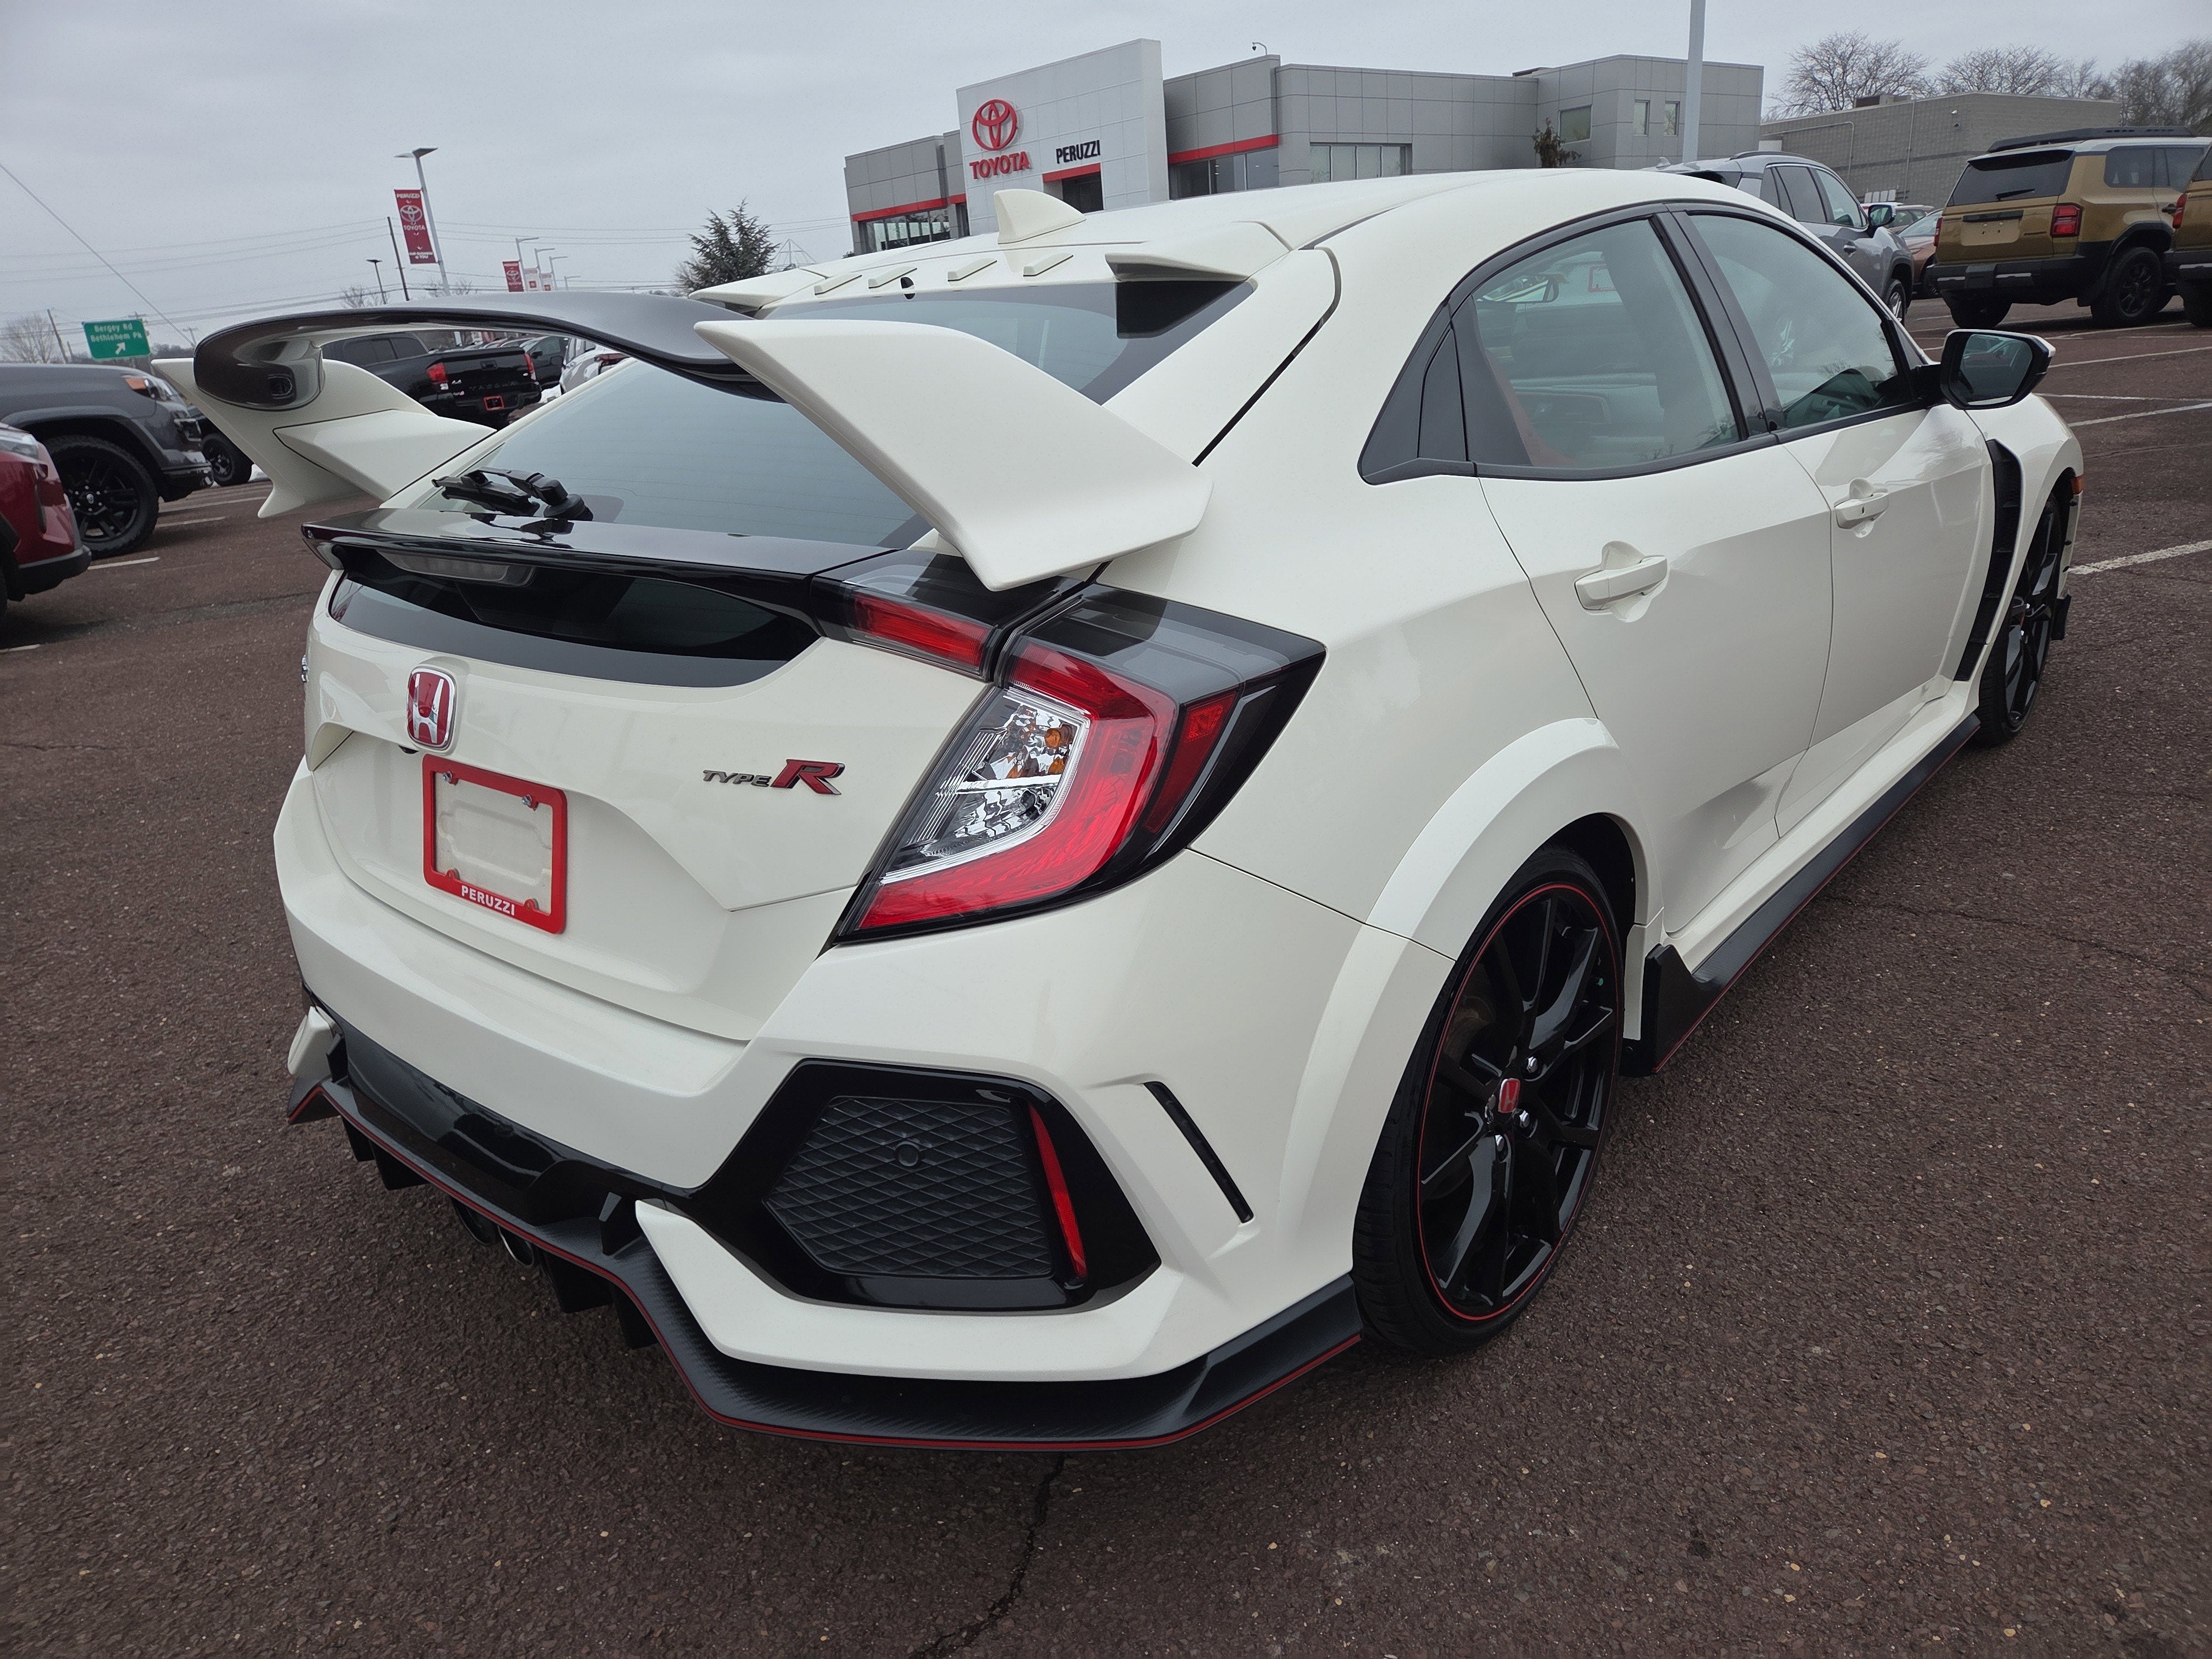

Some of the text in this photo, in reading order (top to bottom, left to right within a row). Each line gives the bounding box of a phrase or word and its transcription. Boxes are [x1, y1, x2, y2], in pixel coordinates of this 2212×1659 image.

[969, 151, 1031, 179] TOYOTA
[1056, 140, 1101, 164] PERUZZI
[703, 759, 845, 795] TYPE R
[461, 885, 515, 916] PERUZZI
